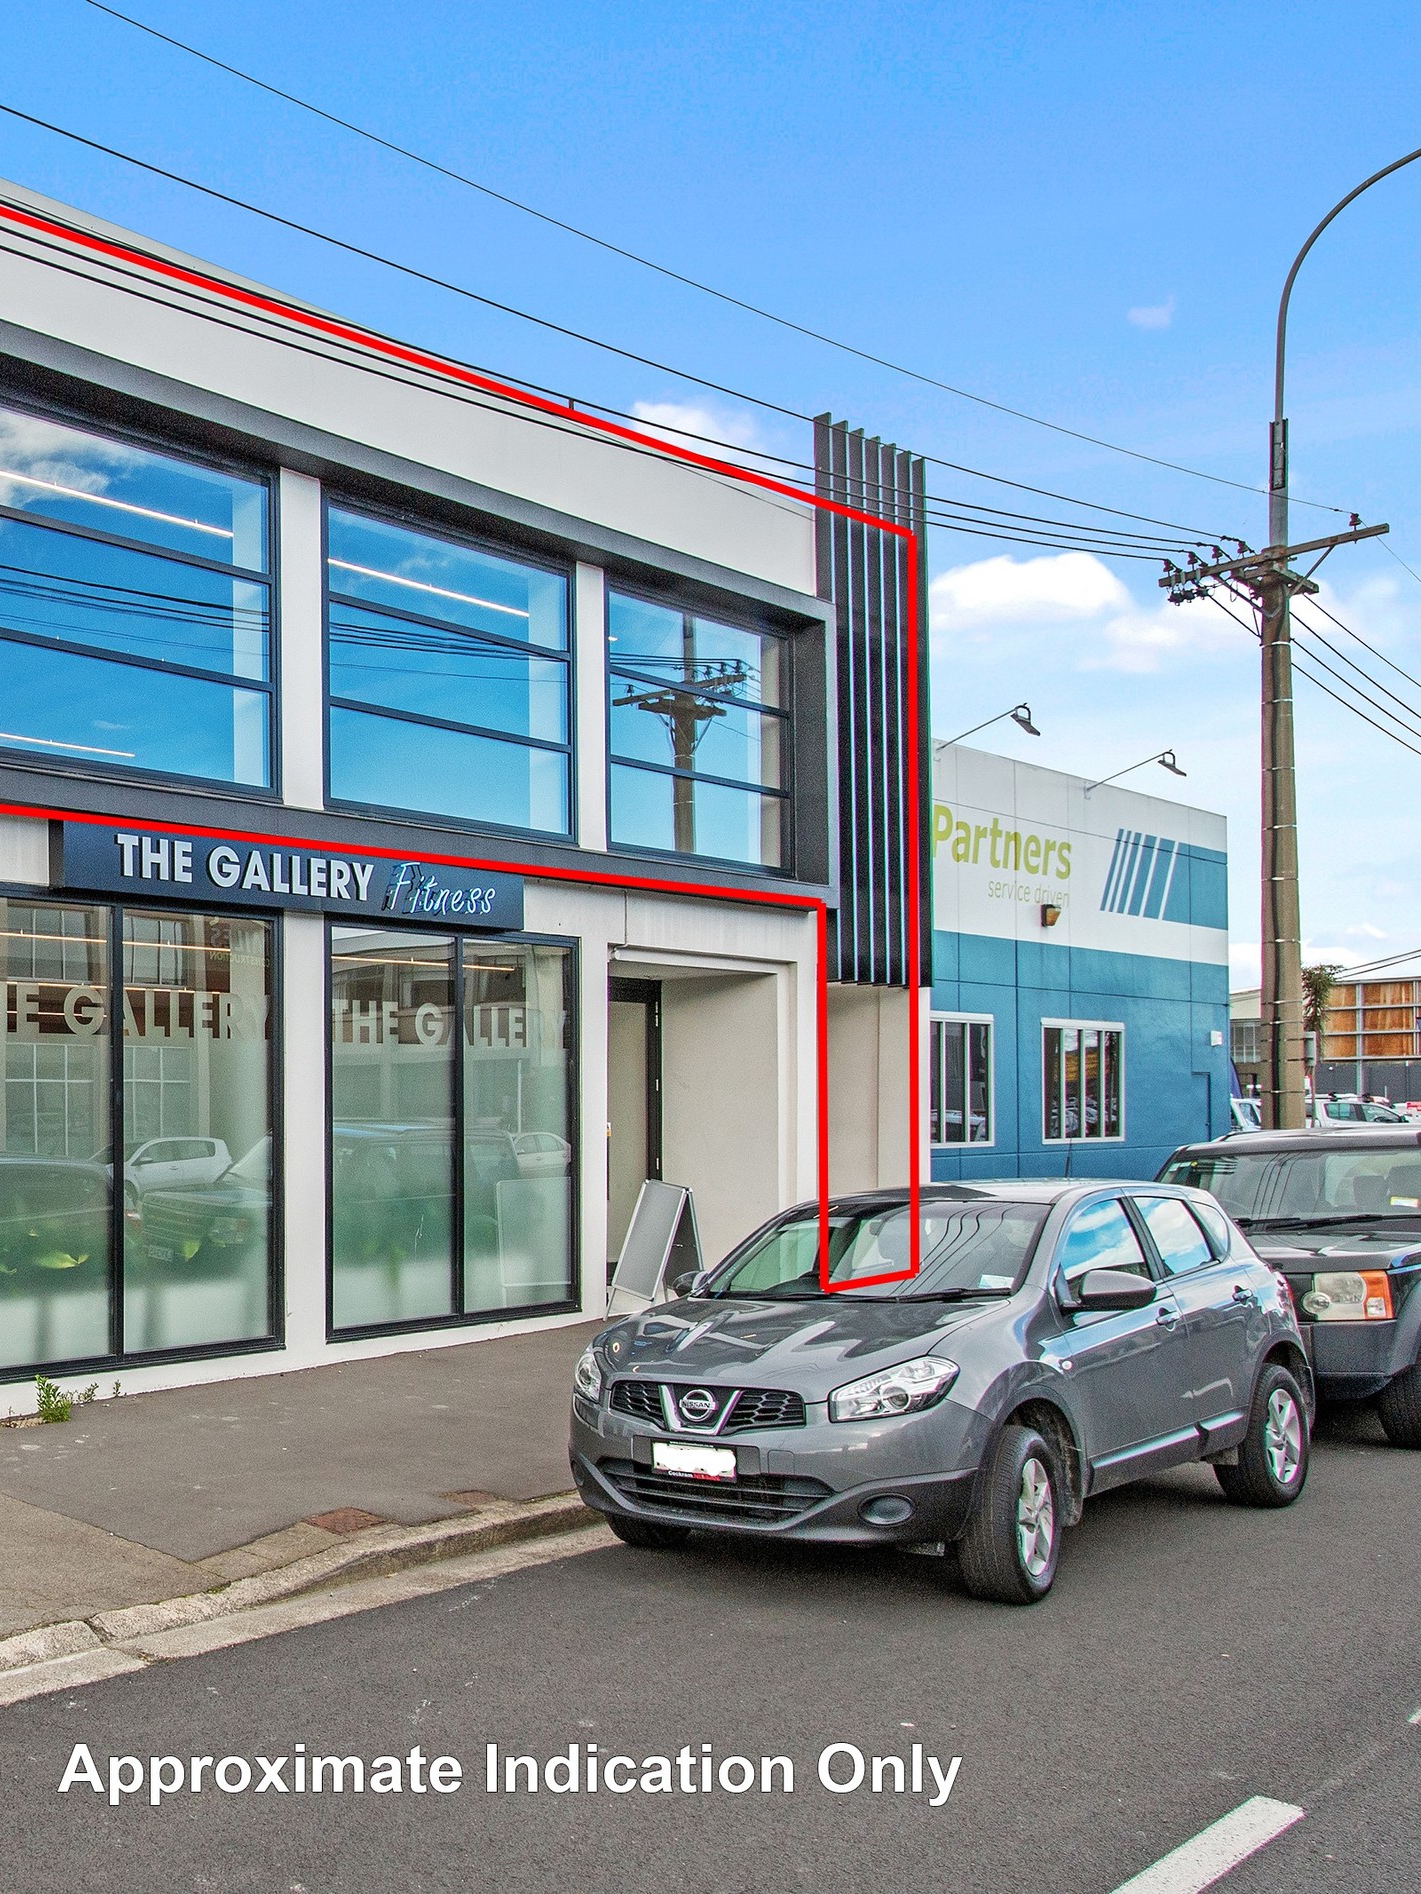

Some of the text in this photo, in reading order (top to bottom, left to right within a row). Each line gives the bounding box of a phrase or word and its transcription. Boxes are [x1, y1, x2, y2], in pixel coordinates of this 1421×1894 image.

[933, 804, 1072, 880] Partners
[117, 832, 496, 915] THE GALLERY Fitness
[987, 880, 1069, 909] service driven
[63, 984, 269, 1041] GALLERY
[332, 998, 400, 1045] THE
[682, 1400, 711, 1408] NISSAN
